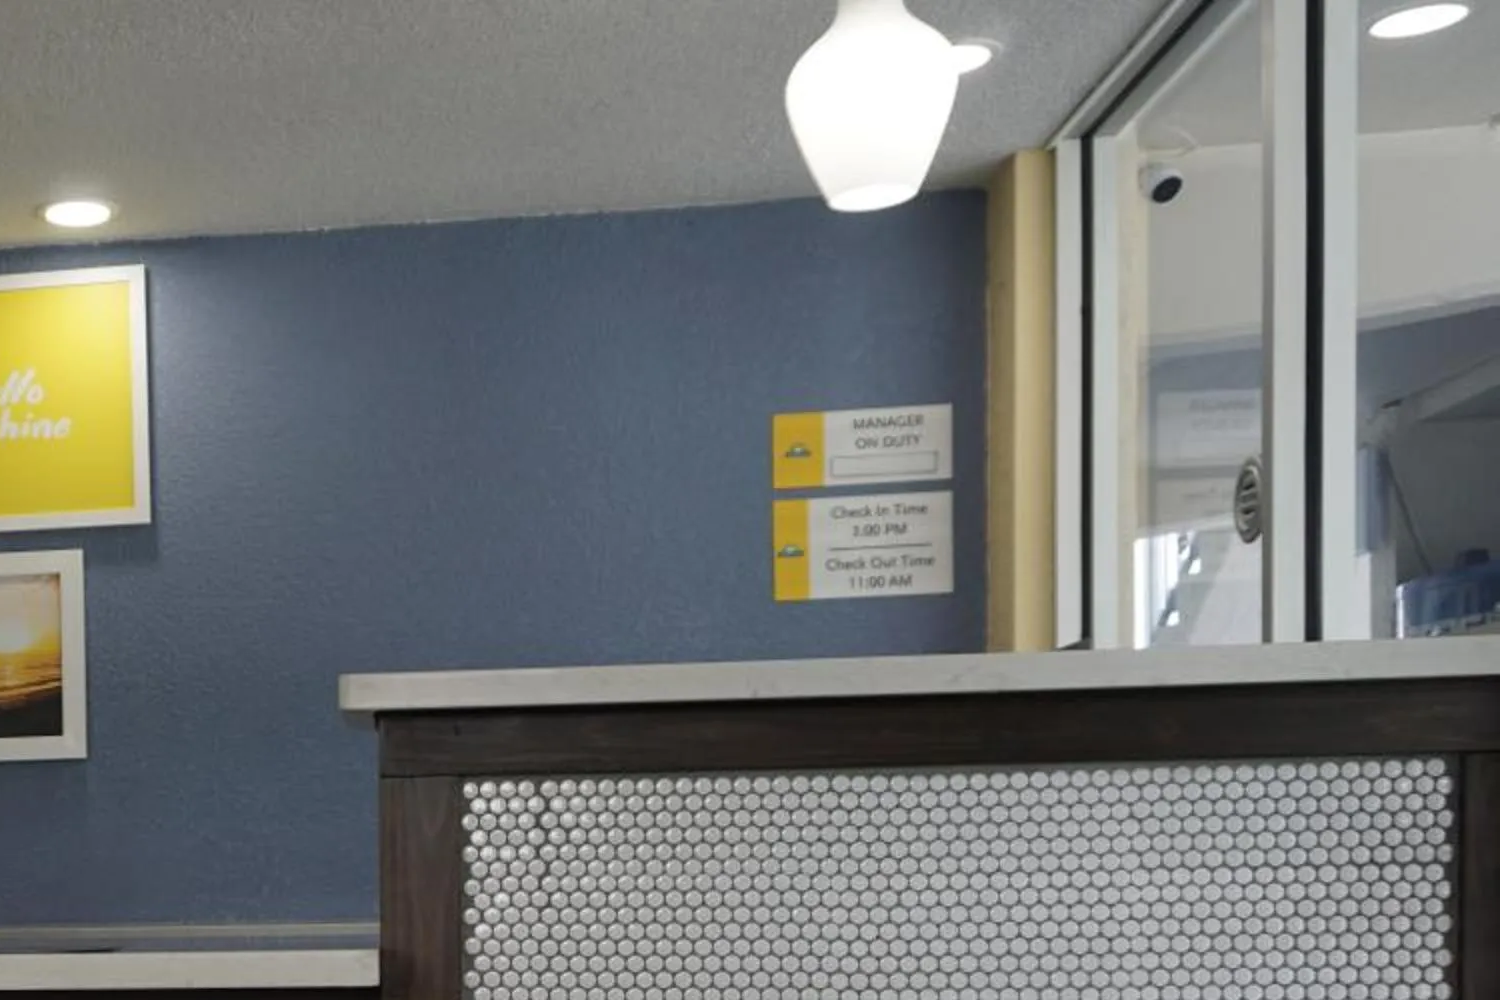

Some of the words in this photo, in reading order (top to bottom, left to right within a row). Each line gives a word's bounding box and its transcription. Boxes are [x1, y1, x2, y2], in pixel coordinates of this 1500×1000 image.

[853, 414, 925, 430] MANAGER
[855, 437, 879, 450] ON
[883, 433, 923, 449] DUTY
[830, 504, 873, 520] Check
[894, 502, 929, 516] Time
[884, 521, 909, 537] PM
[825, 557, 867, 572] Check
[870, 554, 898, 569] Out
[901, 552, 936, 568] Time
[850, 575, 886, 590] 11:00
[888, 574, 914, 589] AM
